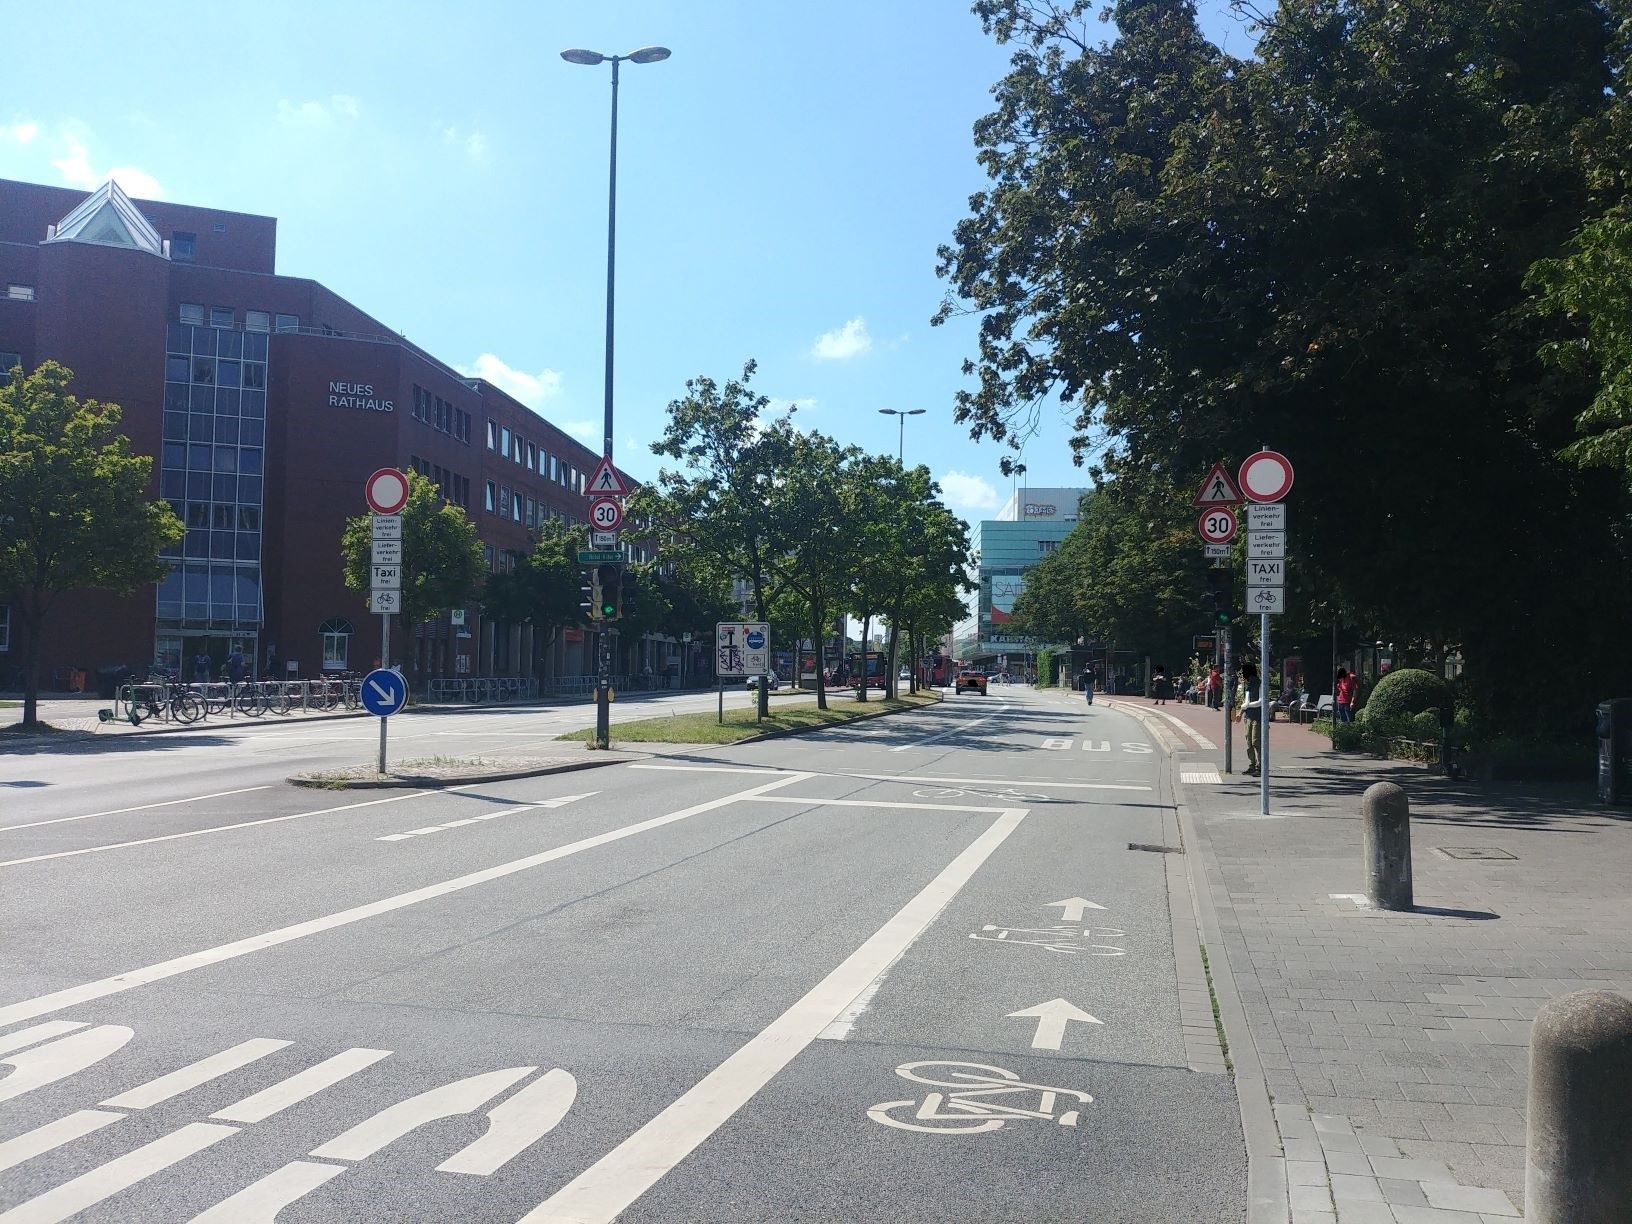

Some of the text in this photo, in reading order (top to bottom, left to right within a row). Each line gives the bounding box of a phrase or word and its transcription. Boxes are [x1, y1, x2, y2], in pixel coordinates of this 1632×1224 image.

[329, 381, 373, 396] NEUES
[329, 395, 394, 412] RATHAUS
[596, 506, 616, 522] 30
[1207, 517, 1229, 534] 30
[374, 567, 396, 577] Taxi
[1251, 563, 1280, 575] TAXI
[1040, 738, 1154, 754] BUS
